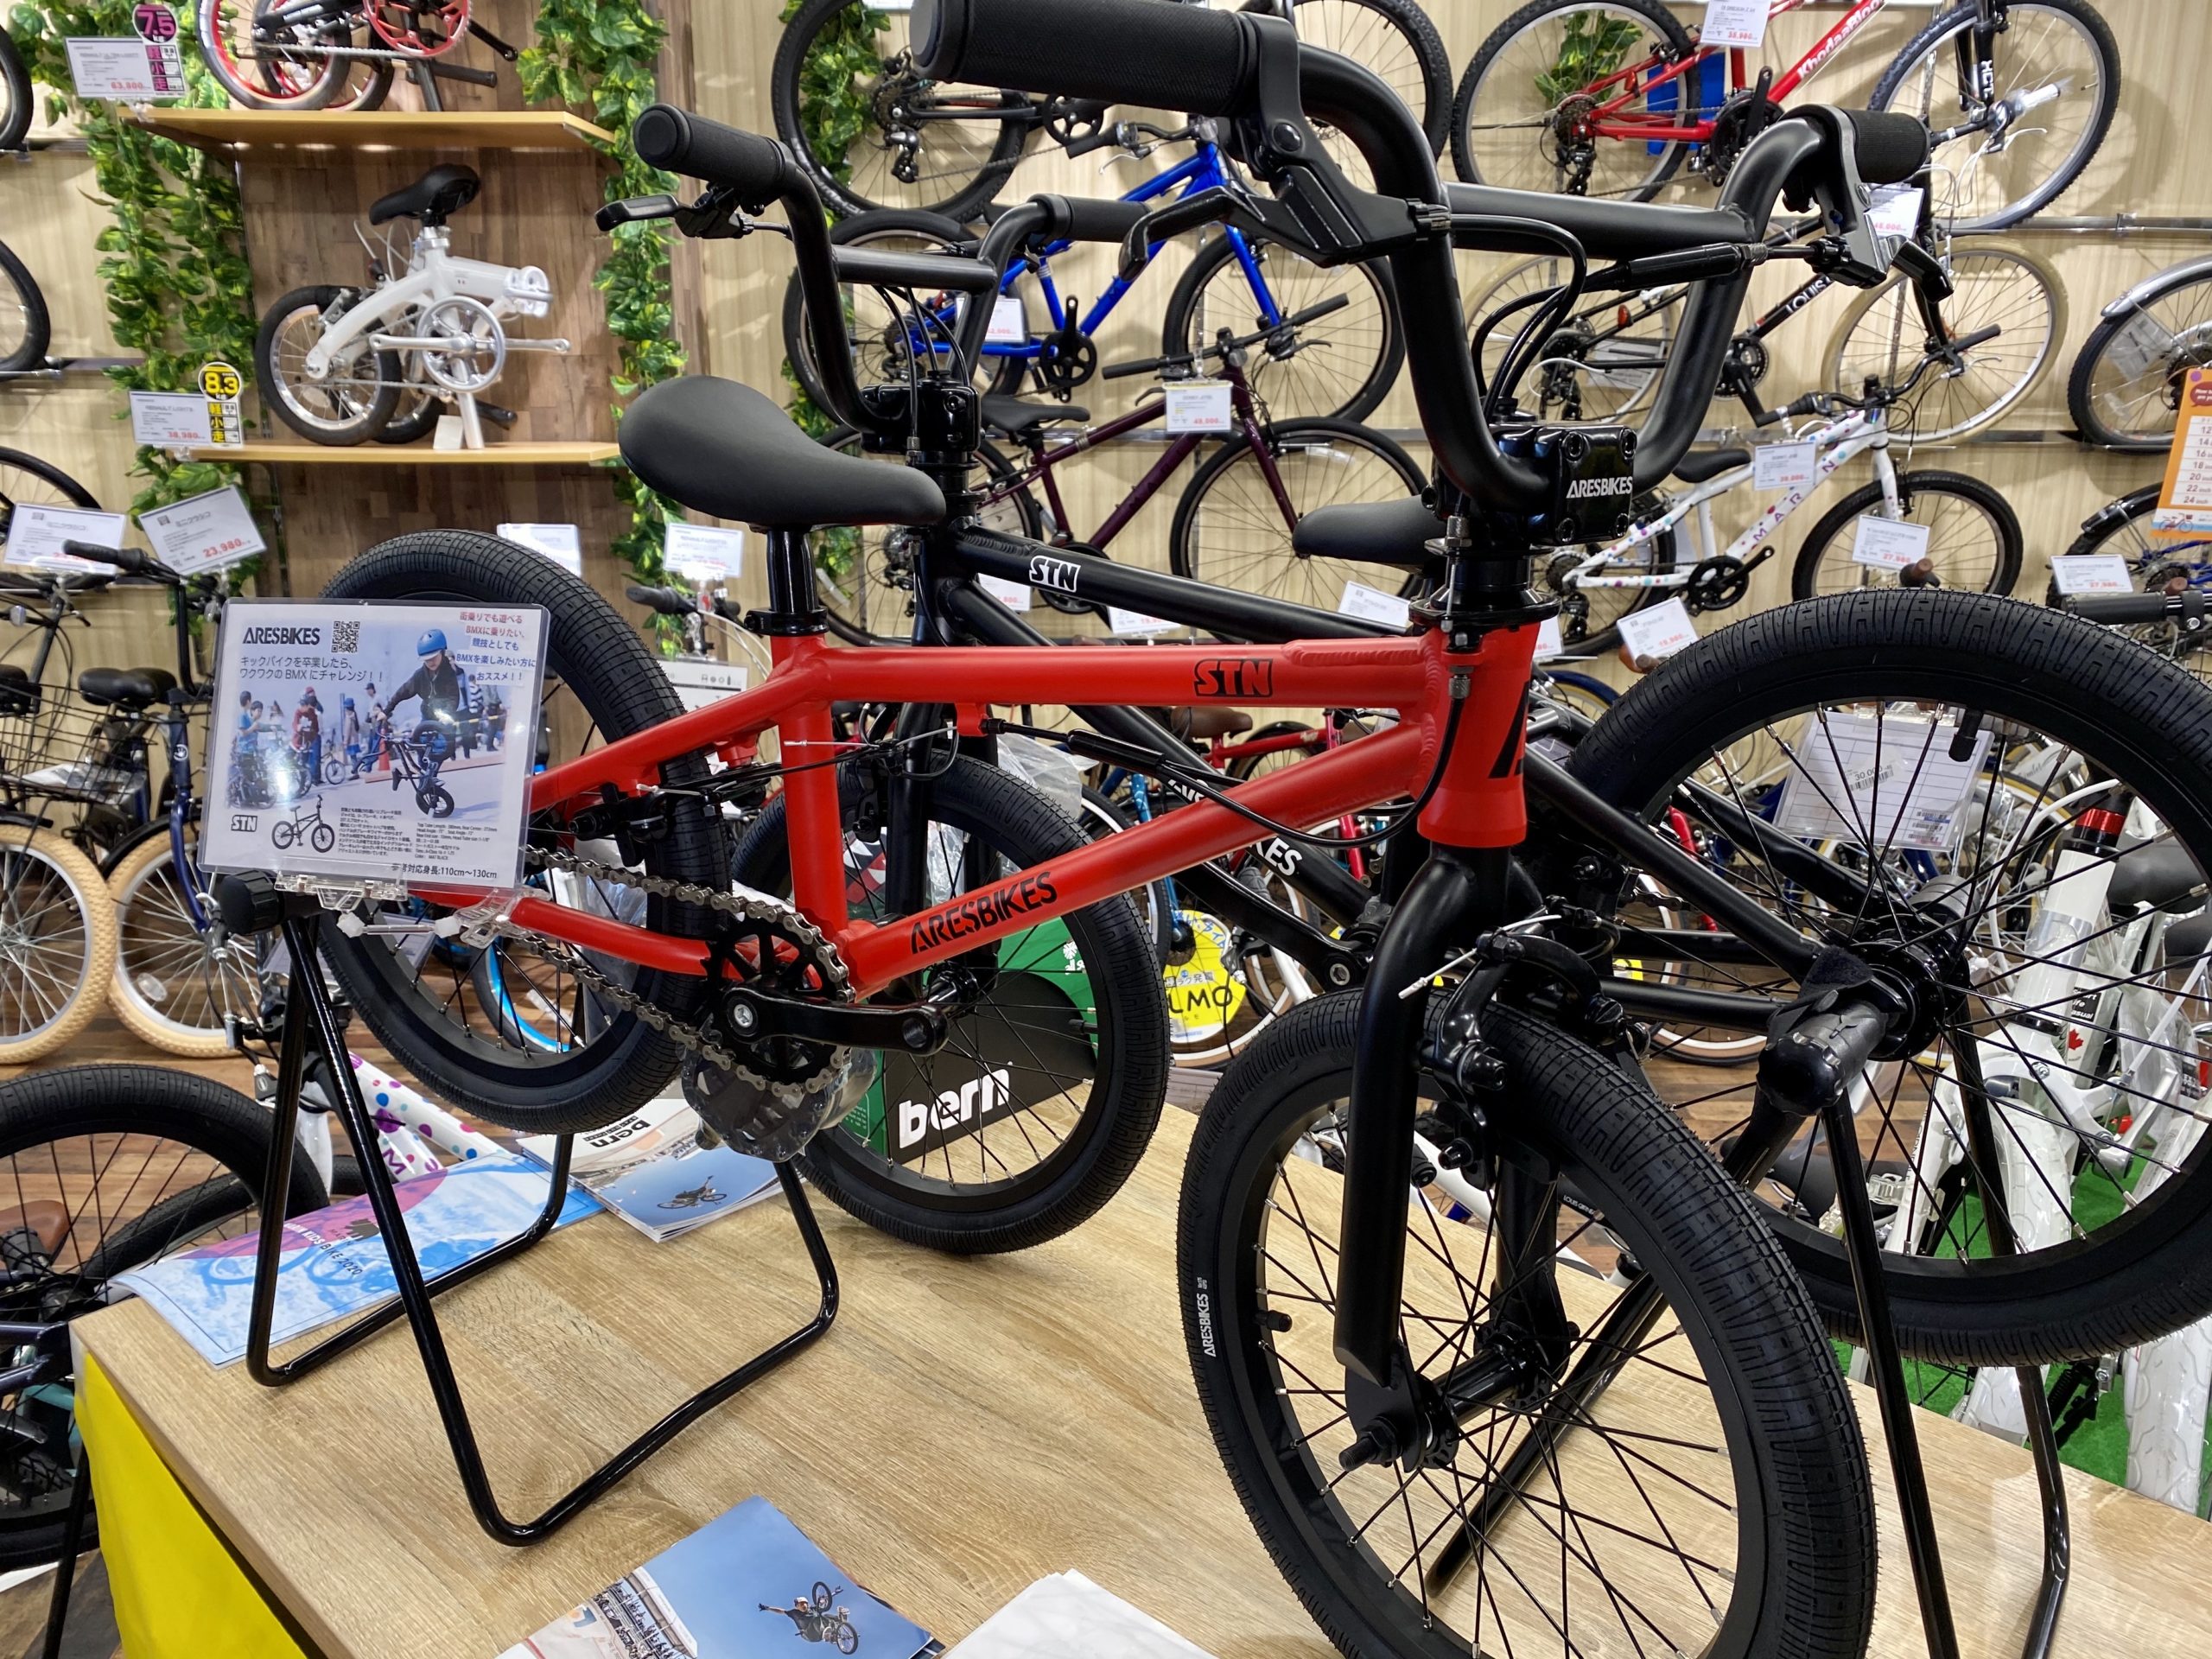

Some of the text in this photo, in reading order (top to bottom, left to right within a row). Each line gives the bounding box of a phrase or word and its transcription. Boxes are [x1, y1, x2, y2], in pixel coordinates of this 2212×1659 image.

[137, 10, 175, 35] 7.5
[150, 61, 165, 75] 小
[204, 371, 239, 395] 8.3
[211, 416, 225, 429] 小
[1565, 476, 1633, 499] ARESBIKES
[2186, 484, 2198, 493] 22
[1029, 555, 1081, 593] STN
[243, 626, 321, 645] ARESBIKES
[472, 638, 519, 652] 競技としても
[1194, 658, 1273, 697] STN
[231, 814, 258, 833] STN
[911, 871, 1058, 955] ARESBIKES
[2071, 1009, 2094, 1019] asual
[899, 1068, 1010, 1149] bern
[590, 1119, 652, 1148] bern
[302, 1230, 326, 1245] KIDS
[320, 1243, 344, 1260] BIKE
[338, 1258, 363, 1275] 2020
[1196, 1293, 1217, 1357] ARESBIKES
